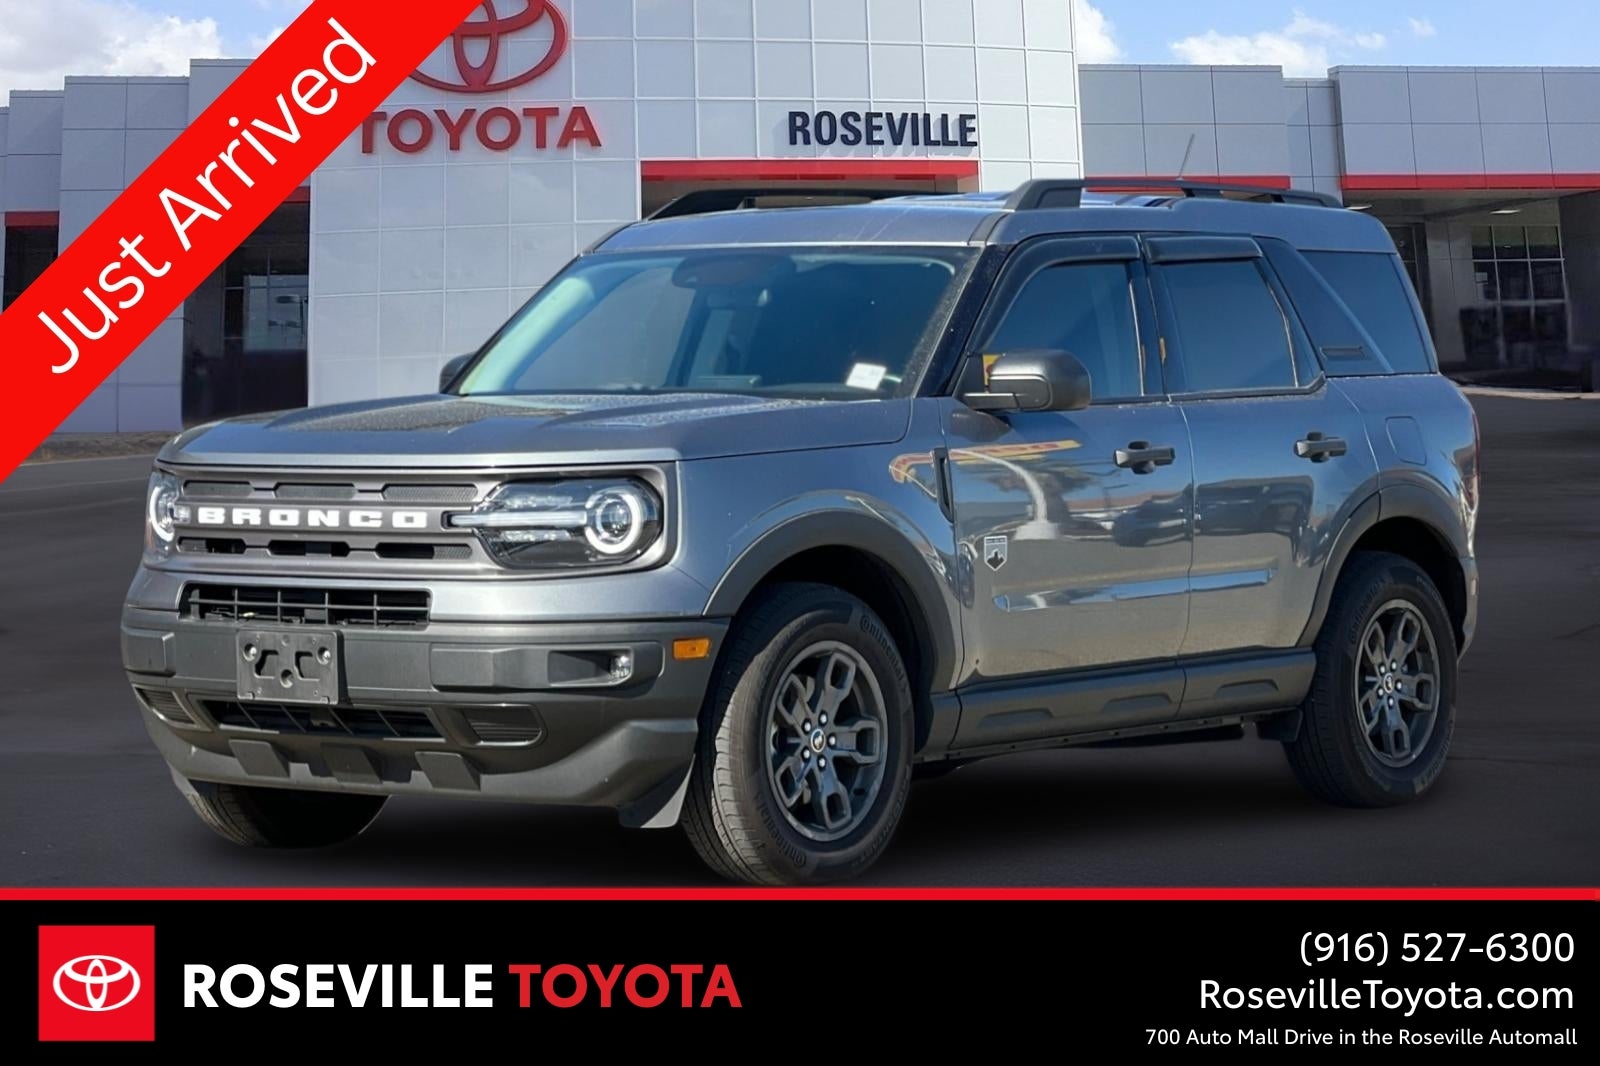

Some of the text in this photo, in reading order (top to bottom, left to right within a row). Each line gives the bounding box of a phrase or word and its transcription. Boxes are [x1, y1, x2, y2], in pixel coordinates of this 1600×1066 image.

[361, 106, 602, 154] TOYOTA
[788, 110, 978, 147] ROSEVILLE
[198, 507, 428, 528] BRONCO
